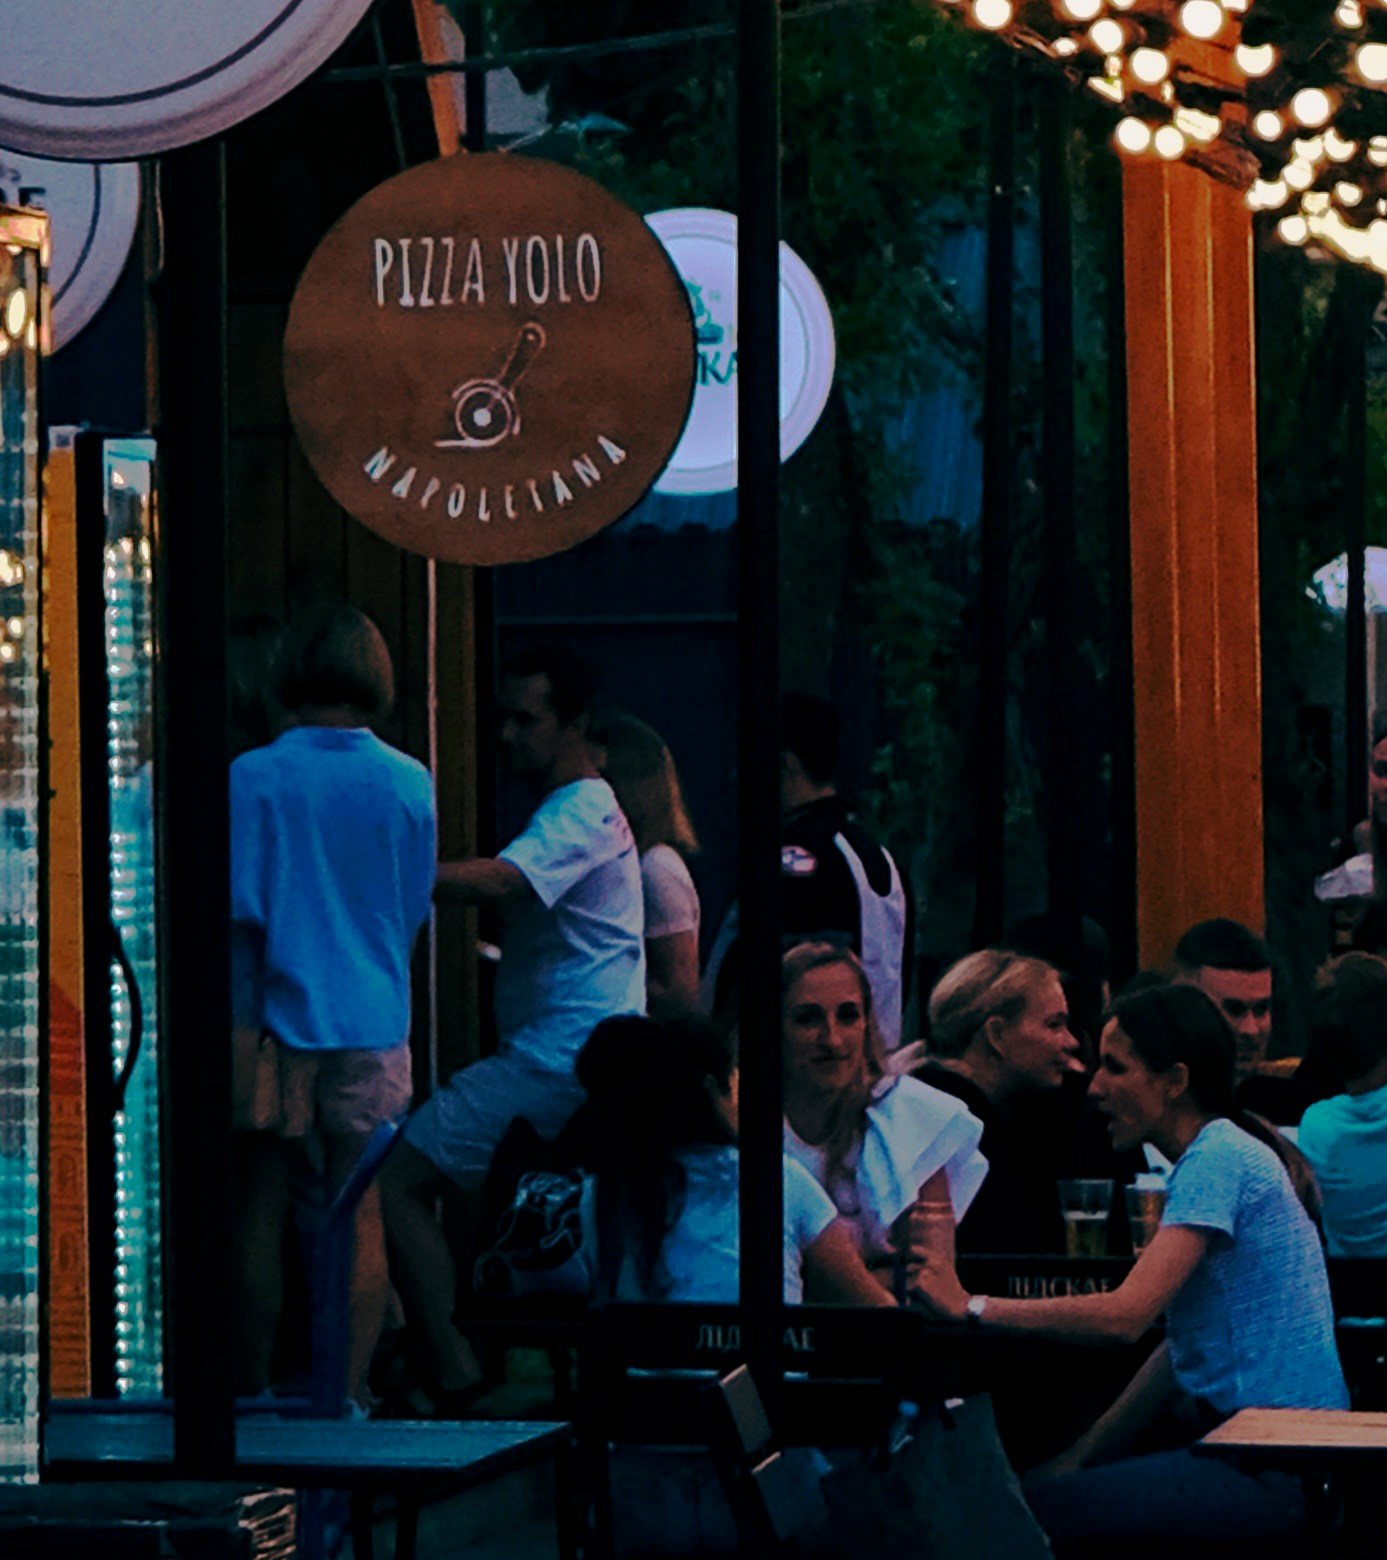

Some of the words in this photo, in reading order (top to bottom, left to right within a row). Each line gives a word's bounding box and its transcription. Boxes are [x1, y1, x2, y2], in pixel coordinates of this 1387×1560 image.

[375, 237, 485, 307] PIZZA
[502, 232, 600, 304] YOLO
[364, 434, 627, 522] NAPOLETANA
